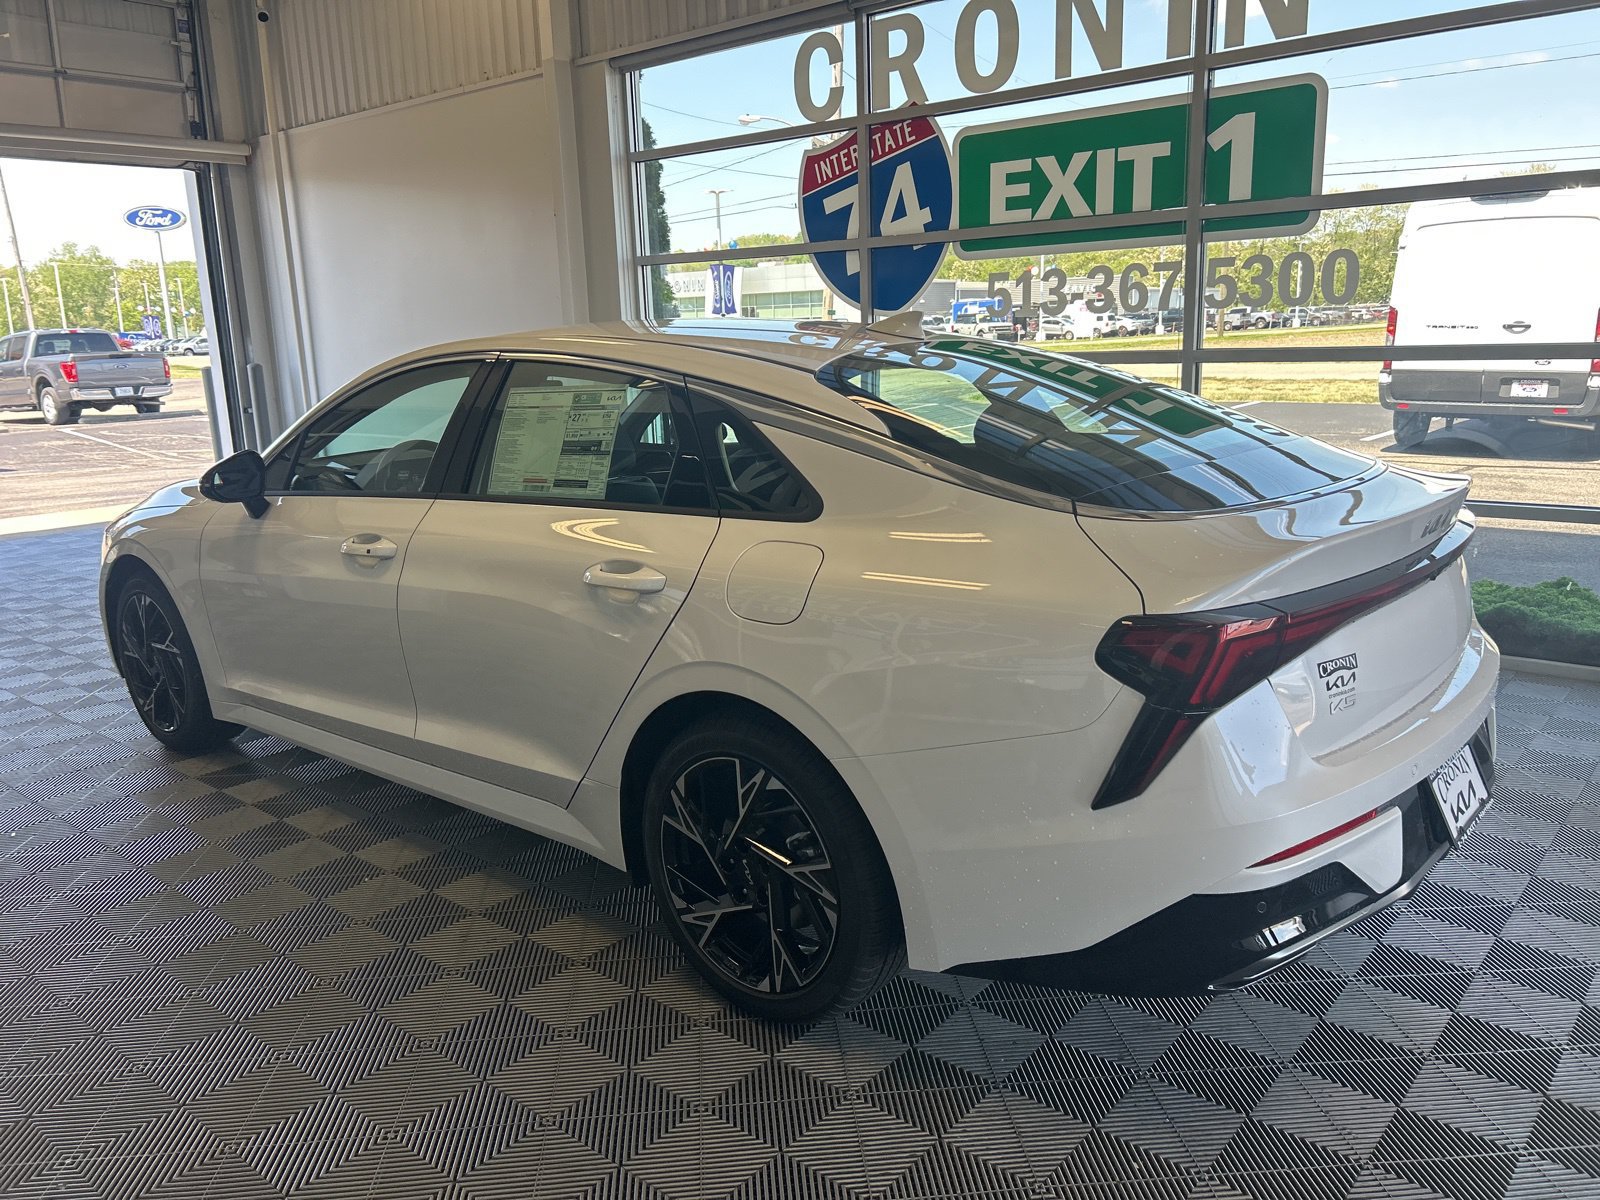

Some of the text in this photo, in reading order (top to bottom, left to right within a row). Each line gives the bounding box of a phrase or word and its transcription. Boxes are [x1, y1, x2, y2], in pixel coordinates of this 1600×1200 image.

[794, 0, 1309, 122] CRONIN
[814, 120, 916, 184] INTERTATE
[989, 112, 1256, 225] EXIT 1
[135, 209, 172, 226] Ford
[822, 161, 933, 276] 74
[986, 248, 1360, 318] 513-3675300
[572, 413, 581, 422] 27
[1319, 654, 1357, 677] CRONIN
[1325, 671, 1356, 692] KIA
[1329, 693, 1357, 716] K5
[1437, 750, 1472, 804] CRONIN
[1450, 779, 1477, 824] KIA
